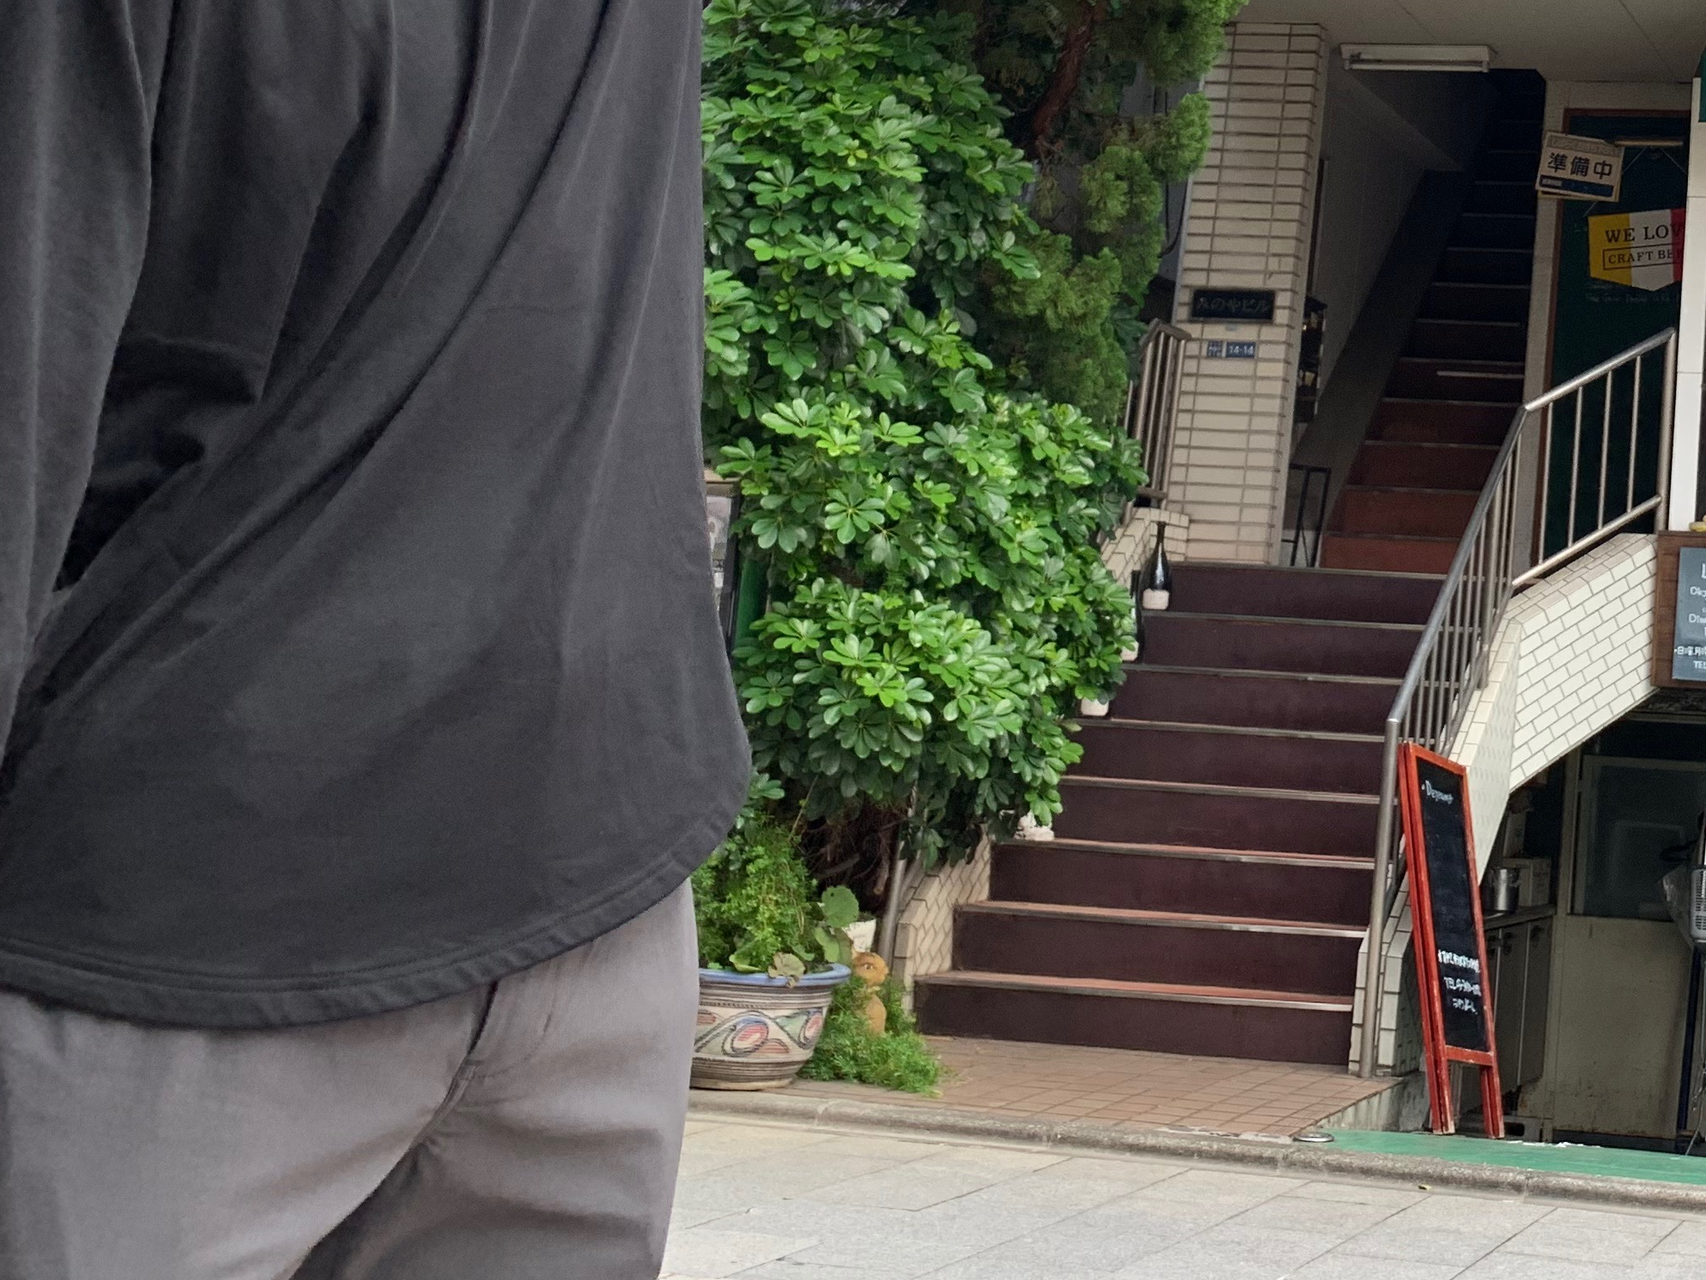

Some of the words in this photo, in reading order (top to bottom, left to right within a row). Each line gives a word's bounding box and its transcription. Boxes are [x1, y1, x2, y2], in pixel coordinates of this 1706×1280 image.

[1547, 152, 1613, 180] 準備中
[1605, 228, 1636, 243] WE
[1608, 251, 1654, 265] CRAFT
